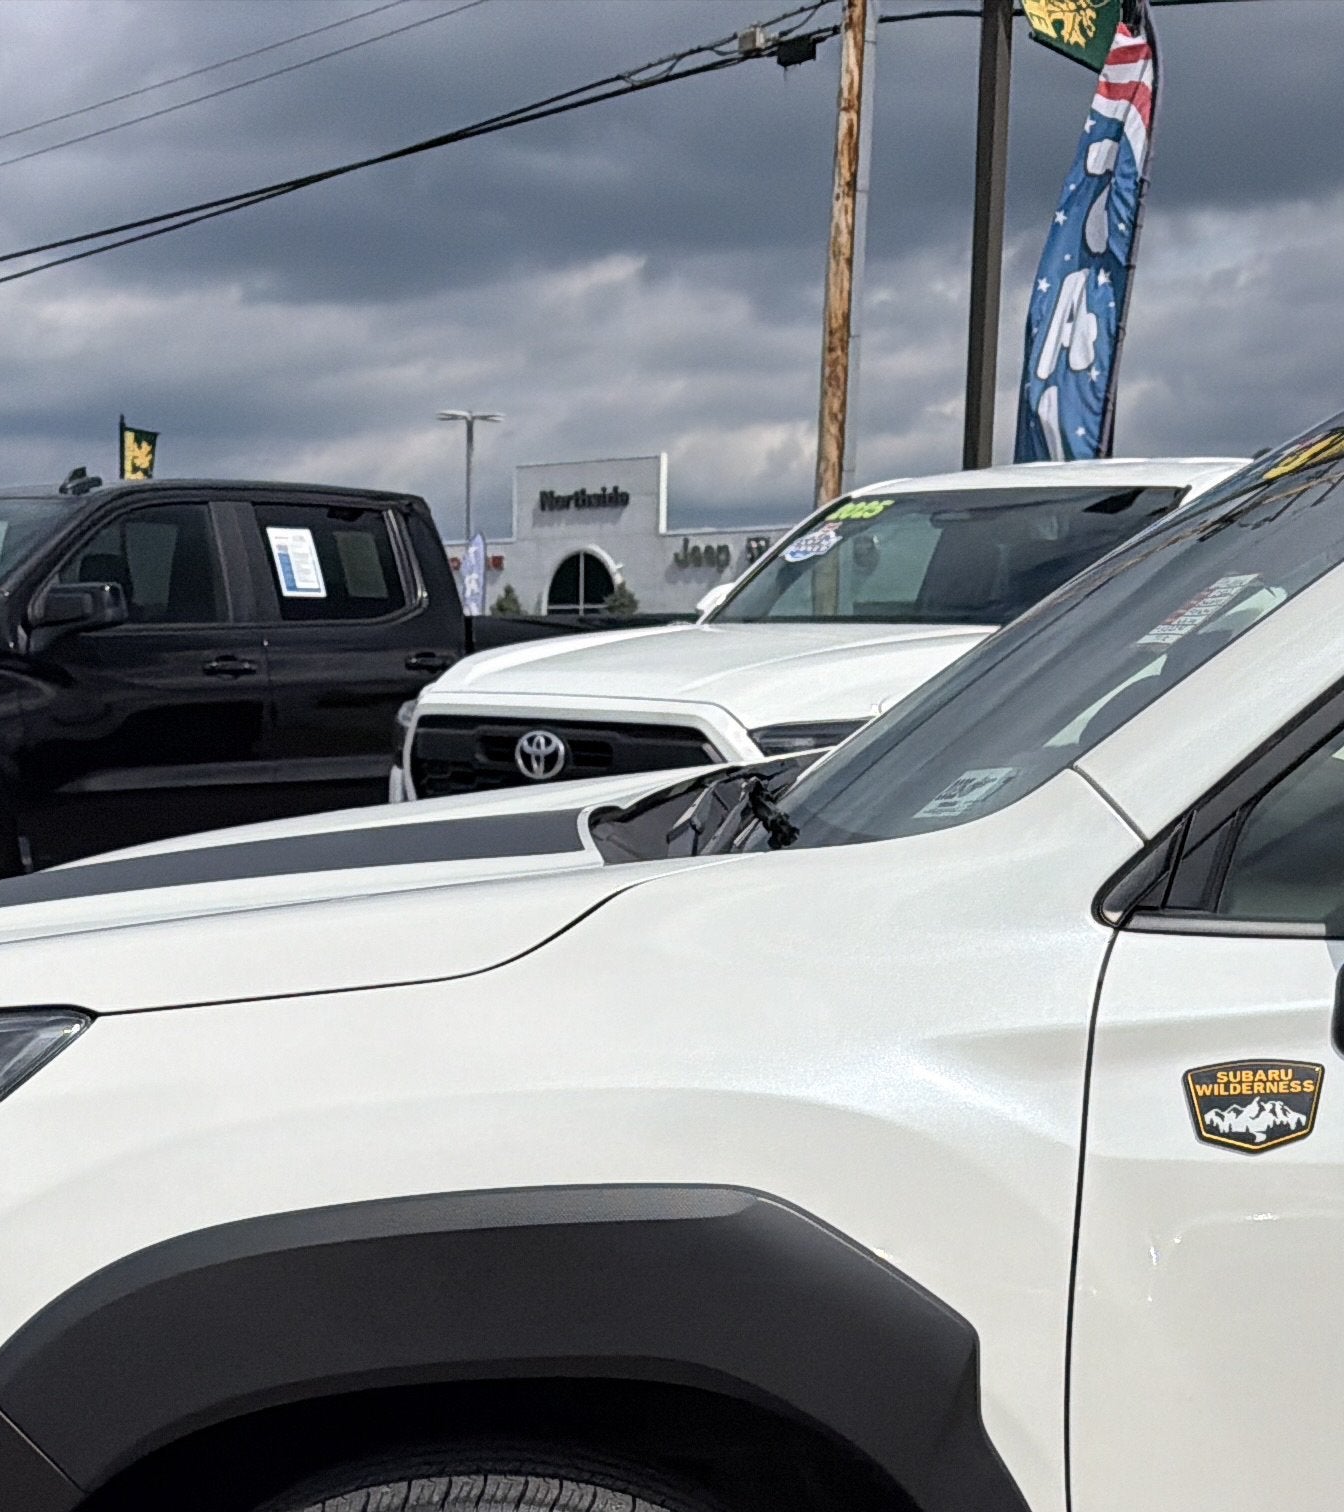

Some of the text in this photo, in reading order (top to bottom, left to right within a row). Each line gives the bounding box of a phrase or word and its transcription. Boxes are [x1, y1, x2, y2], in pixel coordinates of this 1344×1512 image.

[538, 485, 630, 511] Northside
[673, 537, 731, 575] Jeep
[1216, 1069, 1293, 1083] SUBARU
[1196, 1080, 1315, 1096] WILDERNESS
